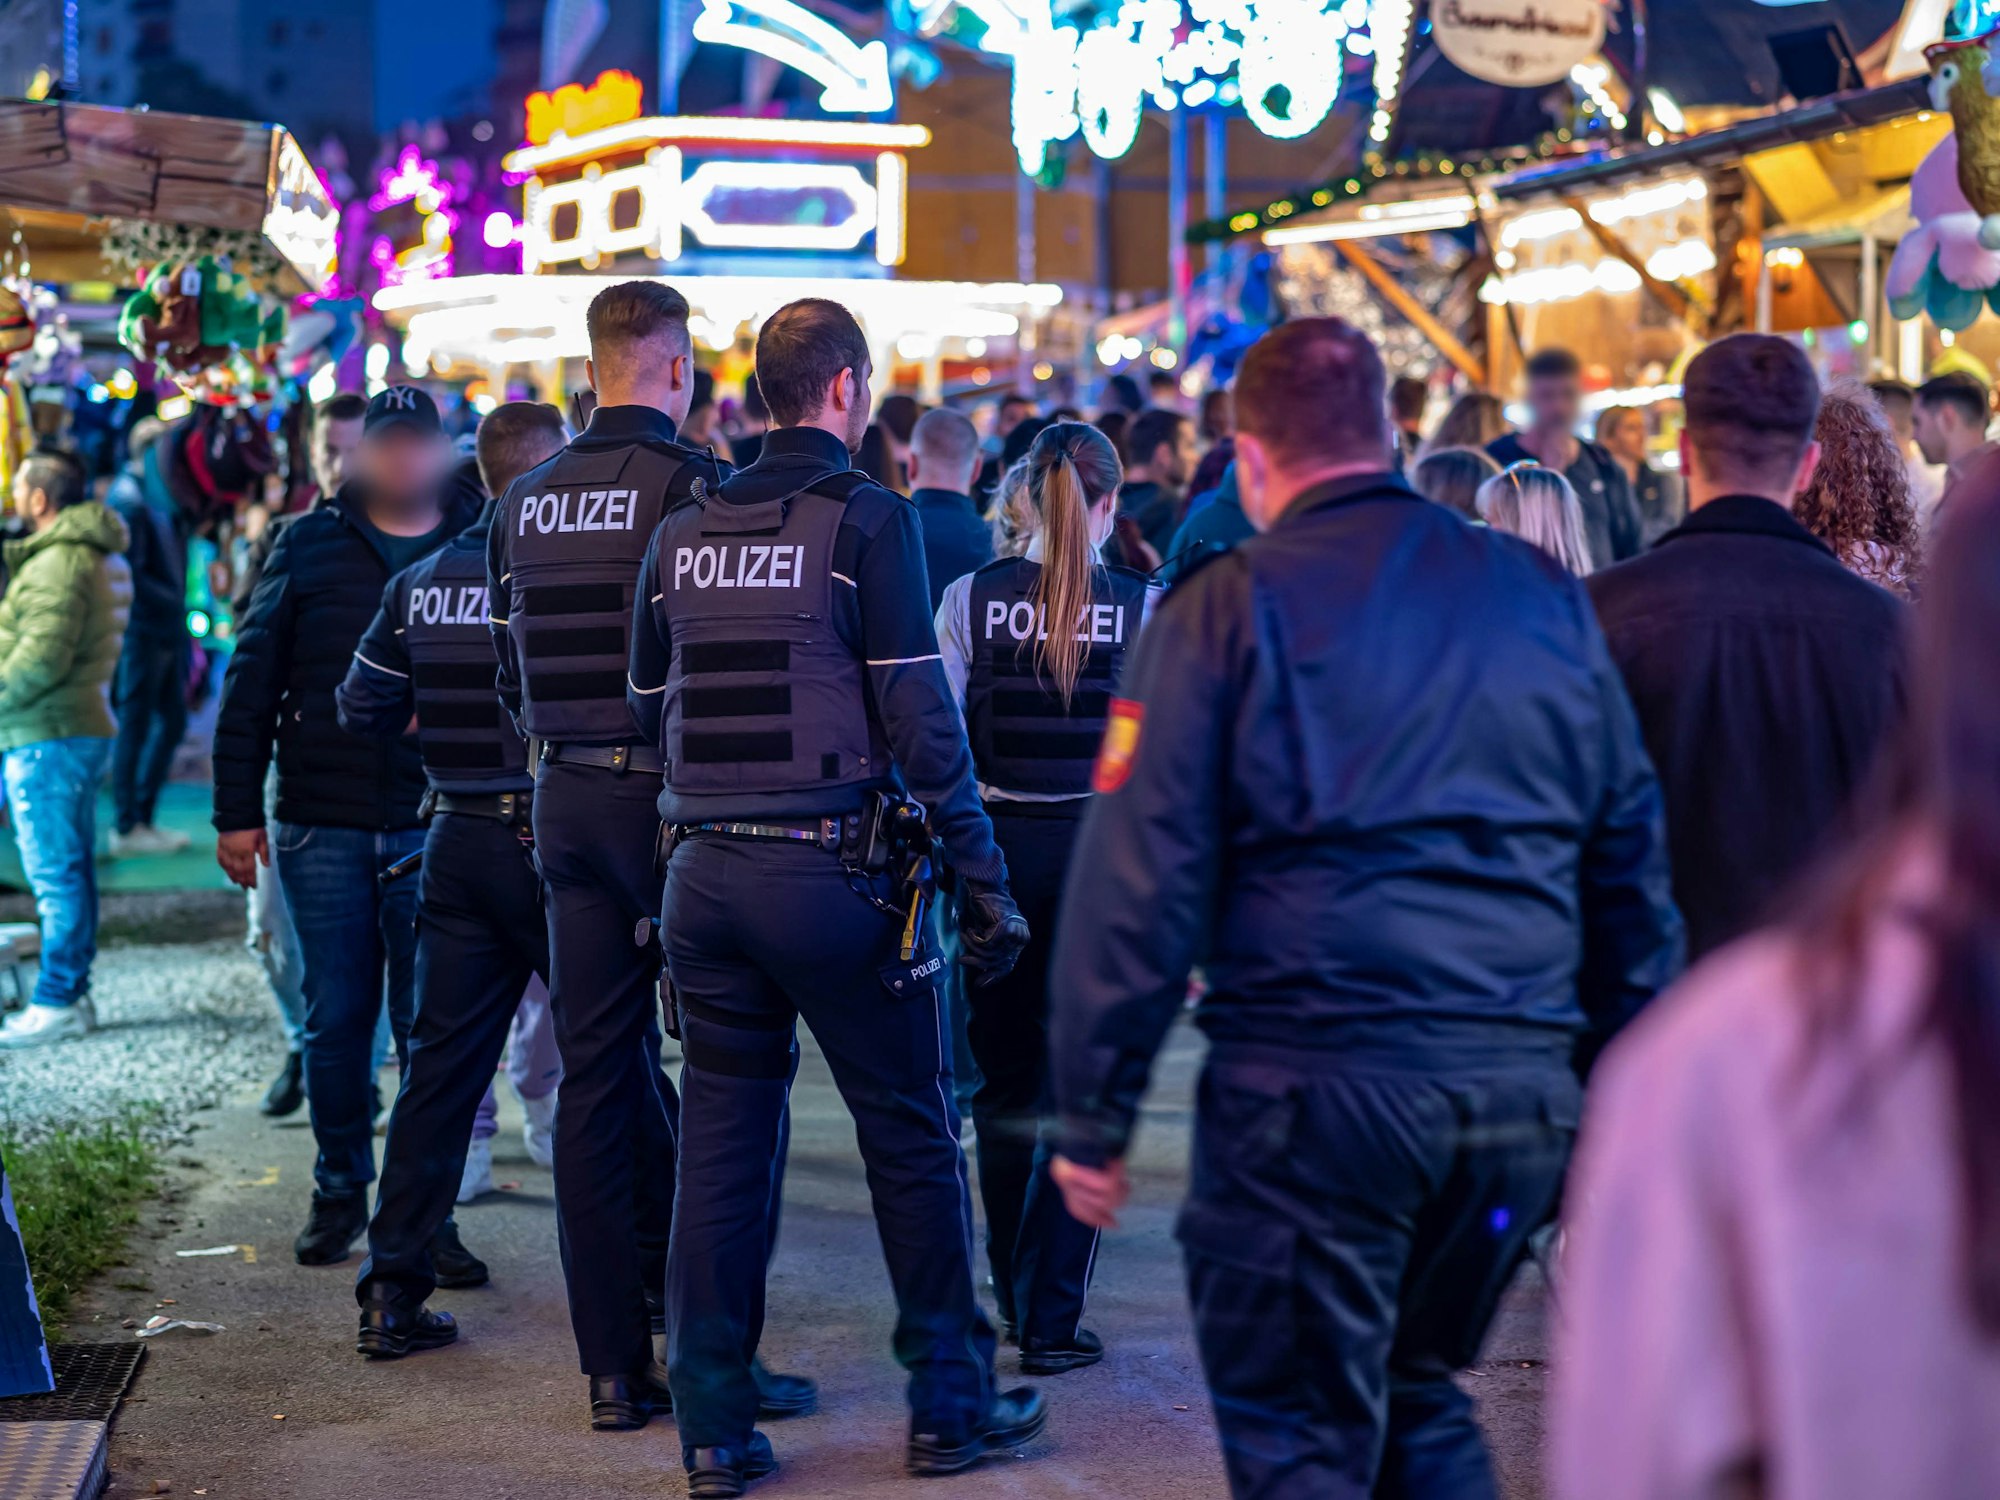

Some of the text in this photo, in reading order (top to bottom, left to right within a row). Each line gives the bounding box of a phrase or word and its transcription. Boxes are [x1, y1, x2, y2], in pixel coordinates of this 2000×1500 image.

[518, 490, 639, 536] POLIZEI
[674, 545, 805, 590] POLIZEI
[408, 586, 490, 626] POLIZE
[985, 600, 1124, 643] POLZEI
[910, 957, 941, 981] POLIZEI
